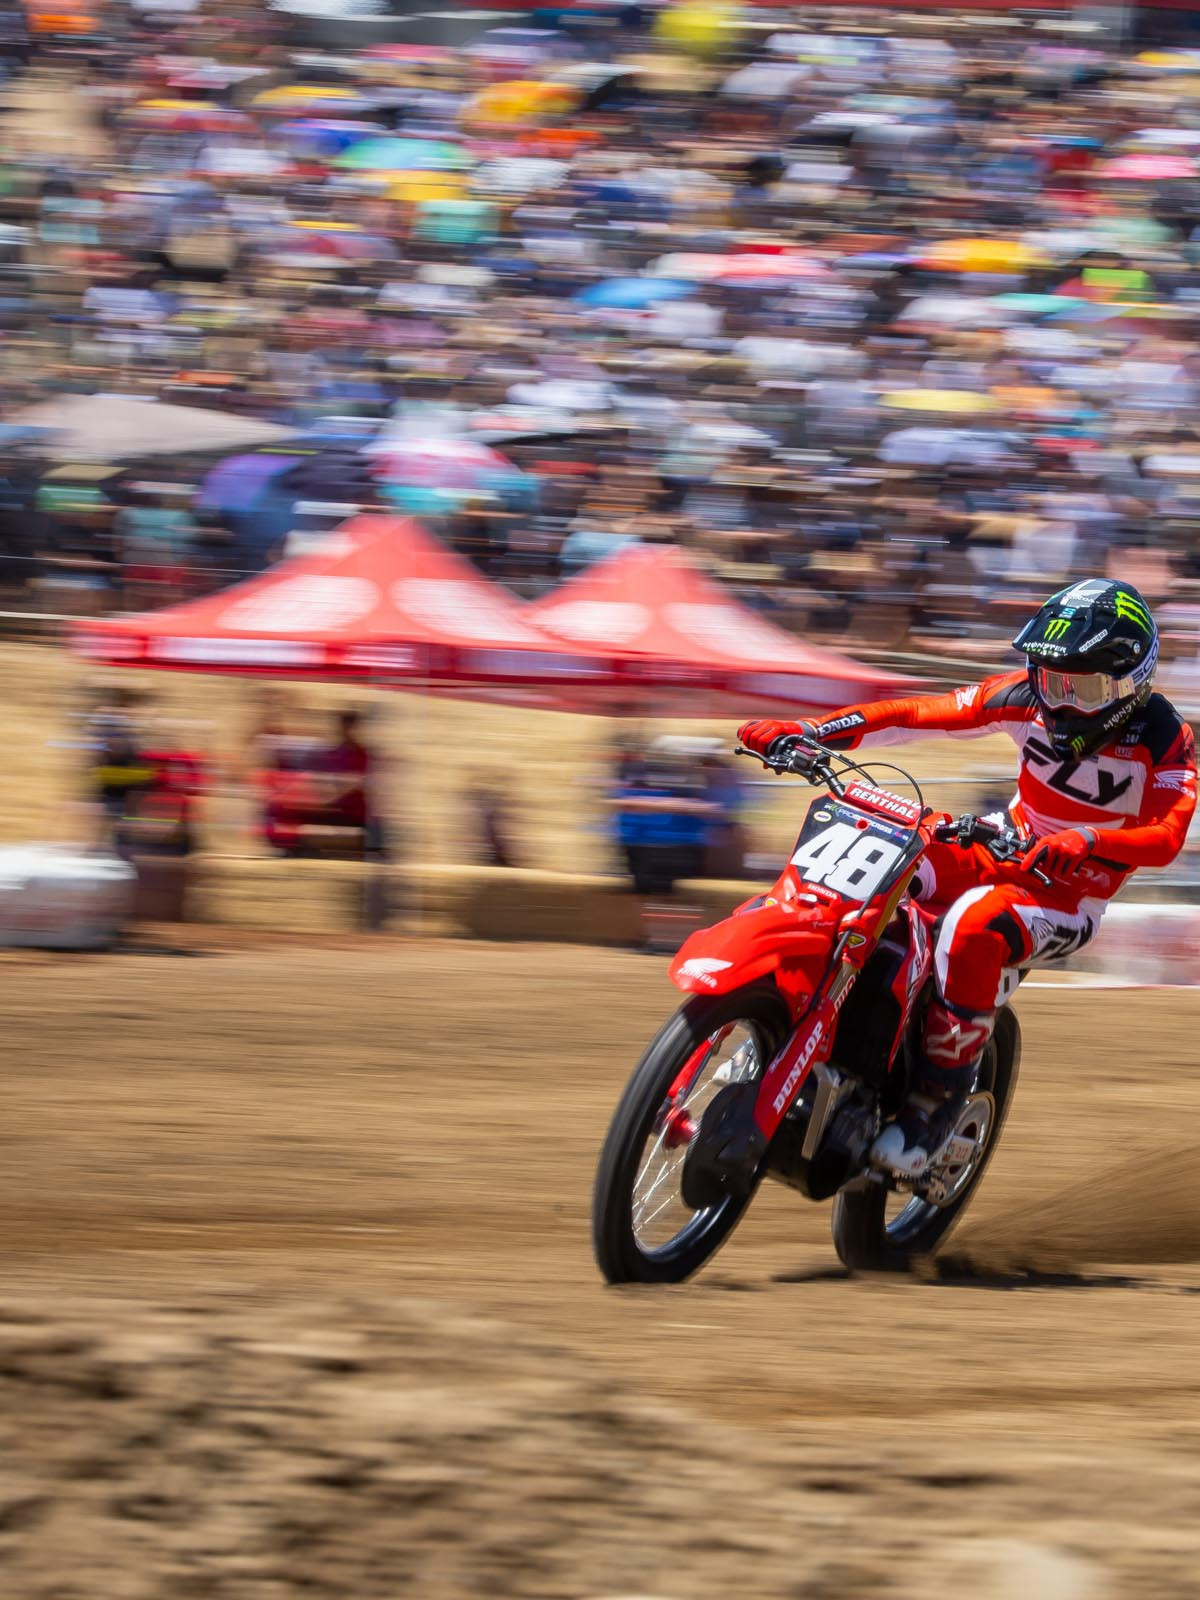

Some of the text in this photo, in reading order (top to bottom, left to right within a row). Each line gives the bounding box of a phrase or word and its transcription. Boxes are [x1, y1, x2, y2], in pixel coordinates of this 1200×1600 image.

[1022, 641, 1067, 654] MONSTER
[1022, 735, 1134, 807] FLY
[849, 787, 915, 819] RENTHAL
[789, 821, 903, 901] 48
[807, 883, 838, 900] HONDA
[677, 967, 718, 989] HONDA
[772, 1020, 824, 1115] DUNLOP
